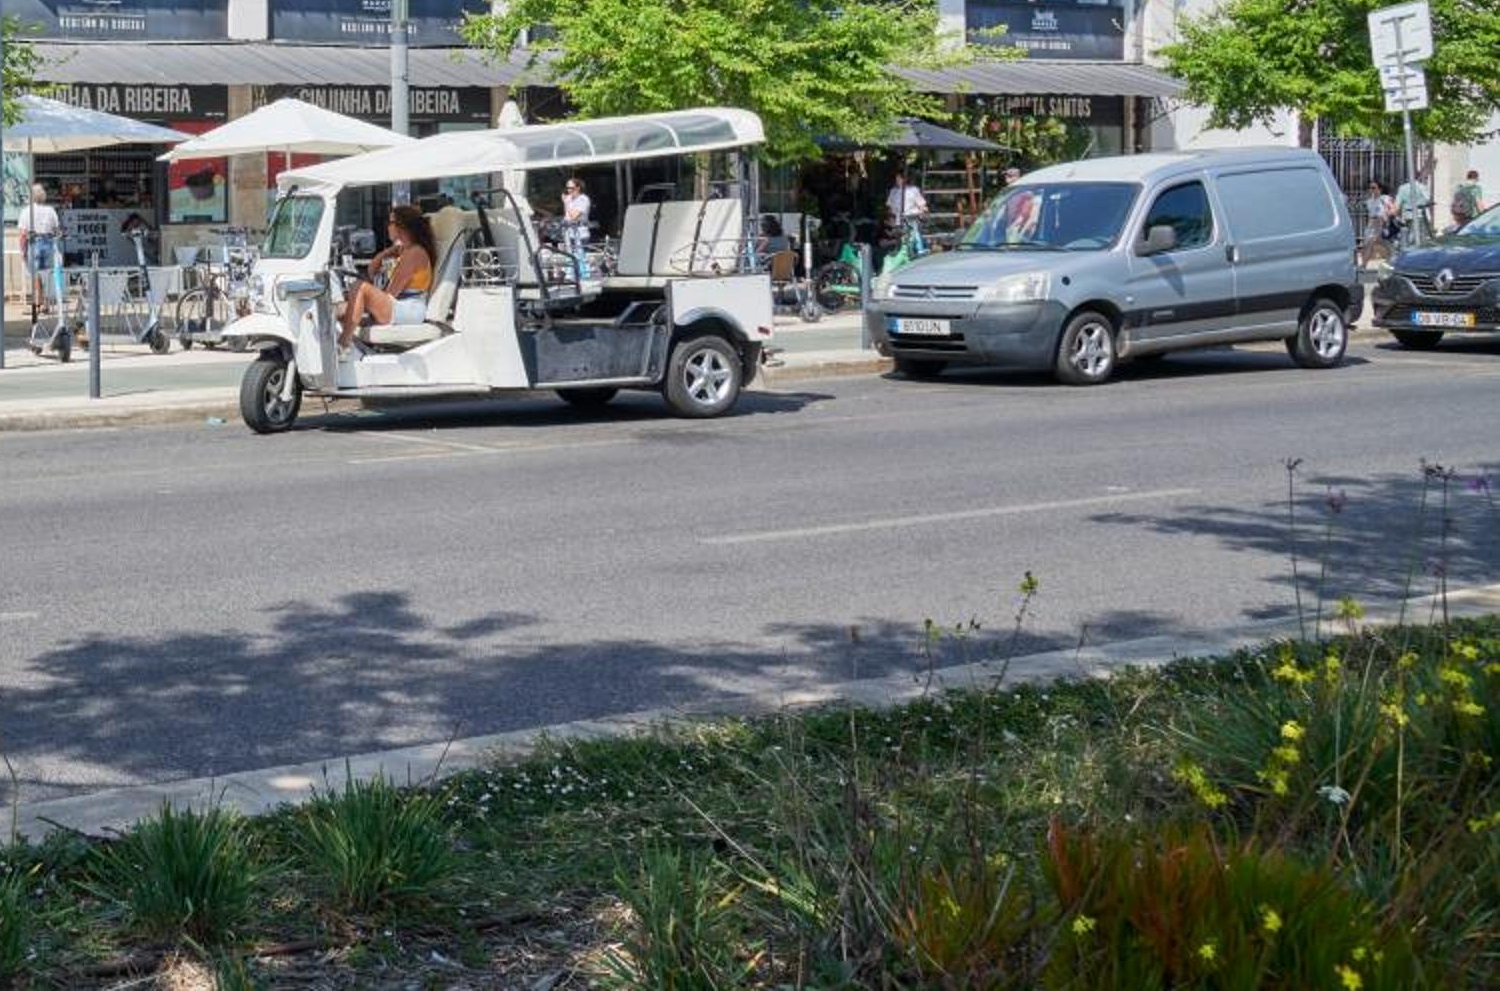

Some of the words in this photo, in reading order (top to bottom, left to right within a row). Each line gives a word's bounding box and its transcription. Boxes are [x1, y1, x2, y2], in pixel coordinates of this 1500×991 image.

[97, 87, 120, 111] DA
[124, 87, 192, 114] RIBEIRA
[410, 90, 460, 114] IBEIRA
